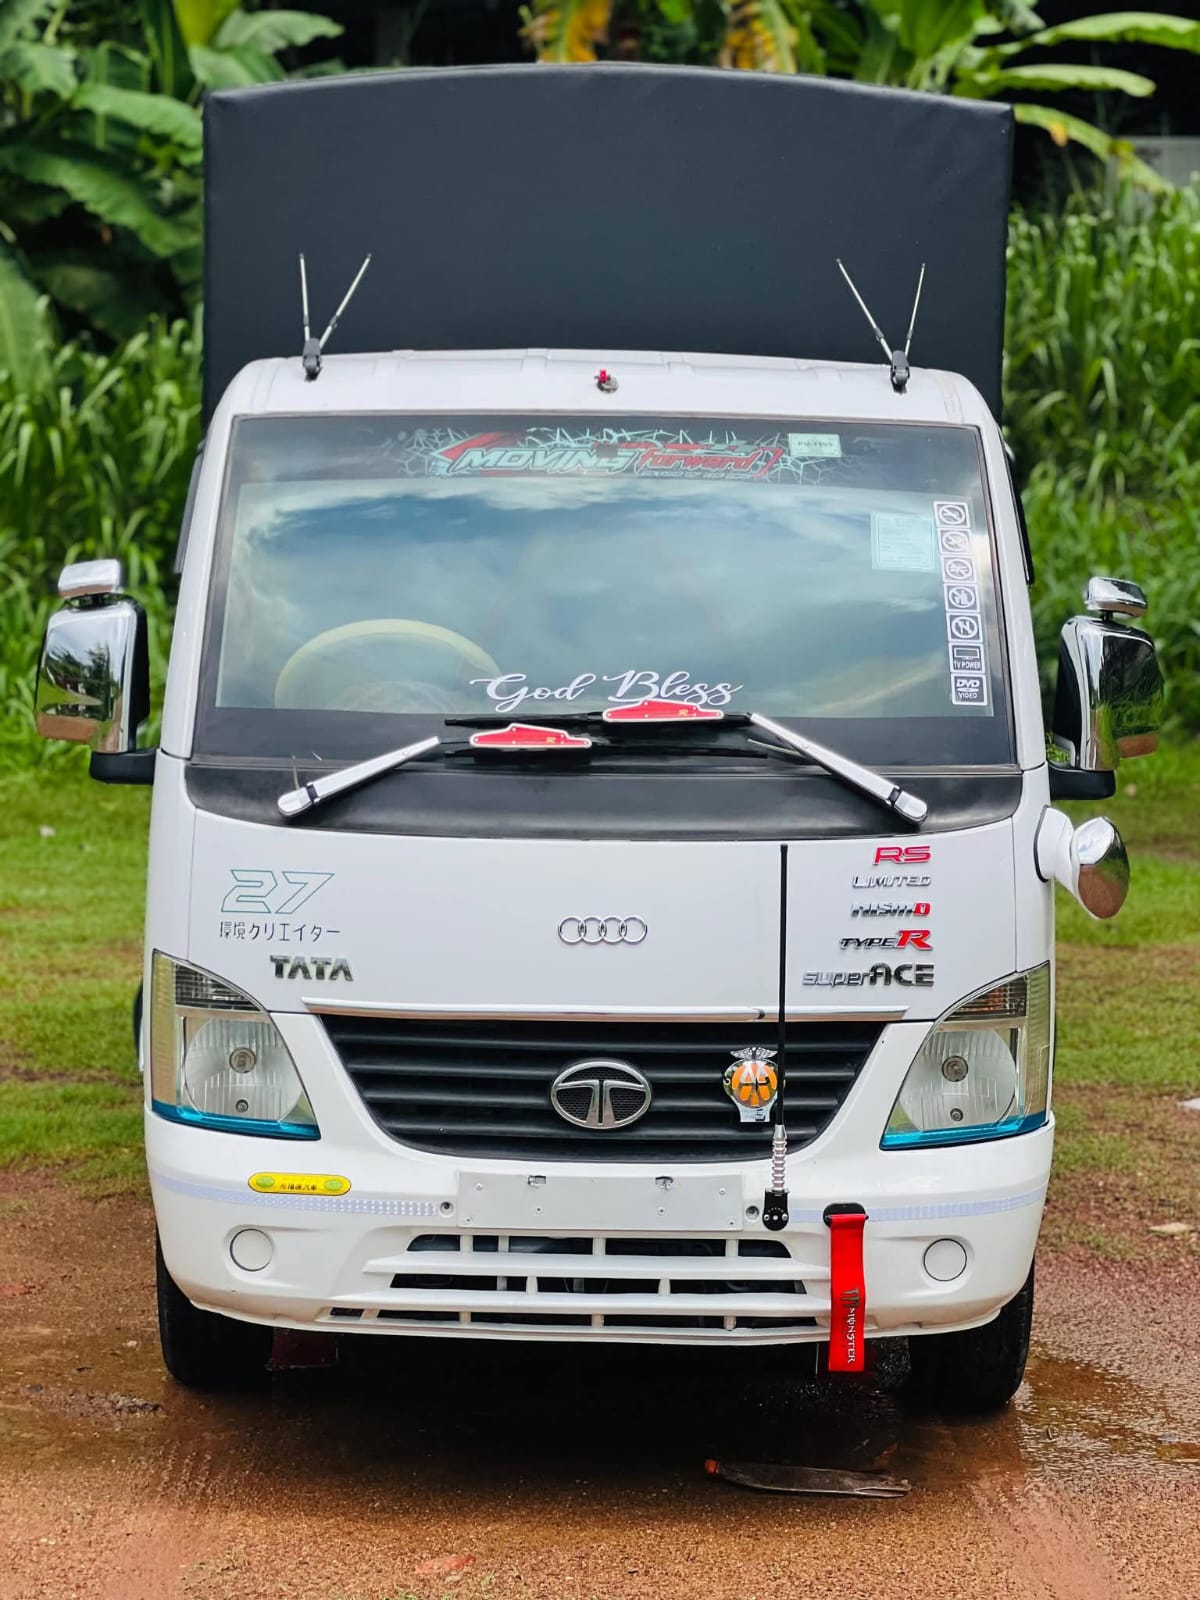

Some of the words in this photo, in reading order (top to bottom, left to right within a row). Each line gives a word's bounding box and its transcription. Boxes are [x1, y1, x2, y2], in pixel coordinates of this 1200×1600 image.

[954, 660, 961, 669] TV
[962, 660, 981, 670] POWER
[469, 673, 596, 713] God
[603, 669, 743, 706] Bless
[956, 679, 980, 688] DVD
[873, 845, 932, 865] RS
[220, 869, 336, 915] 27
[852, 874, 931, 889] LIMITED
[219, 921, 341, 942] 環境クリエイター
[270, 954, 354, 982] TATA
[847, 1307, 857, 1364] MONSTER
